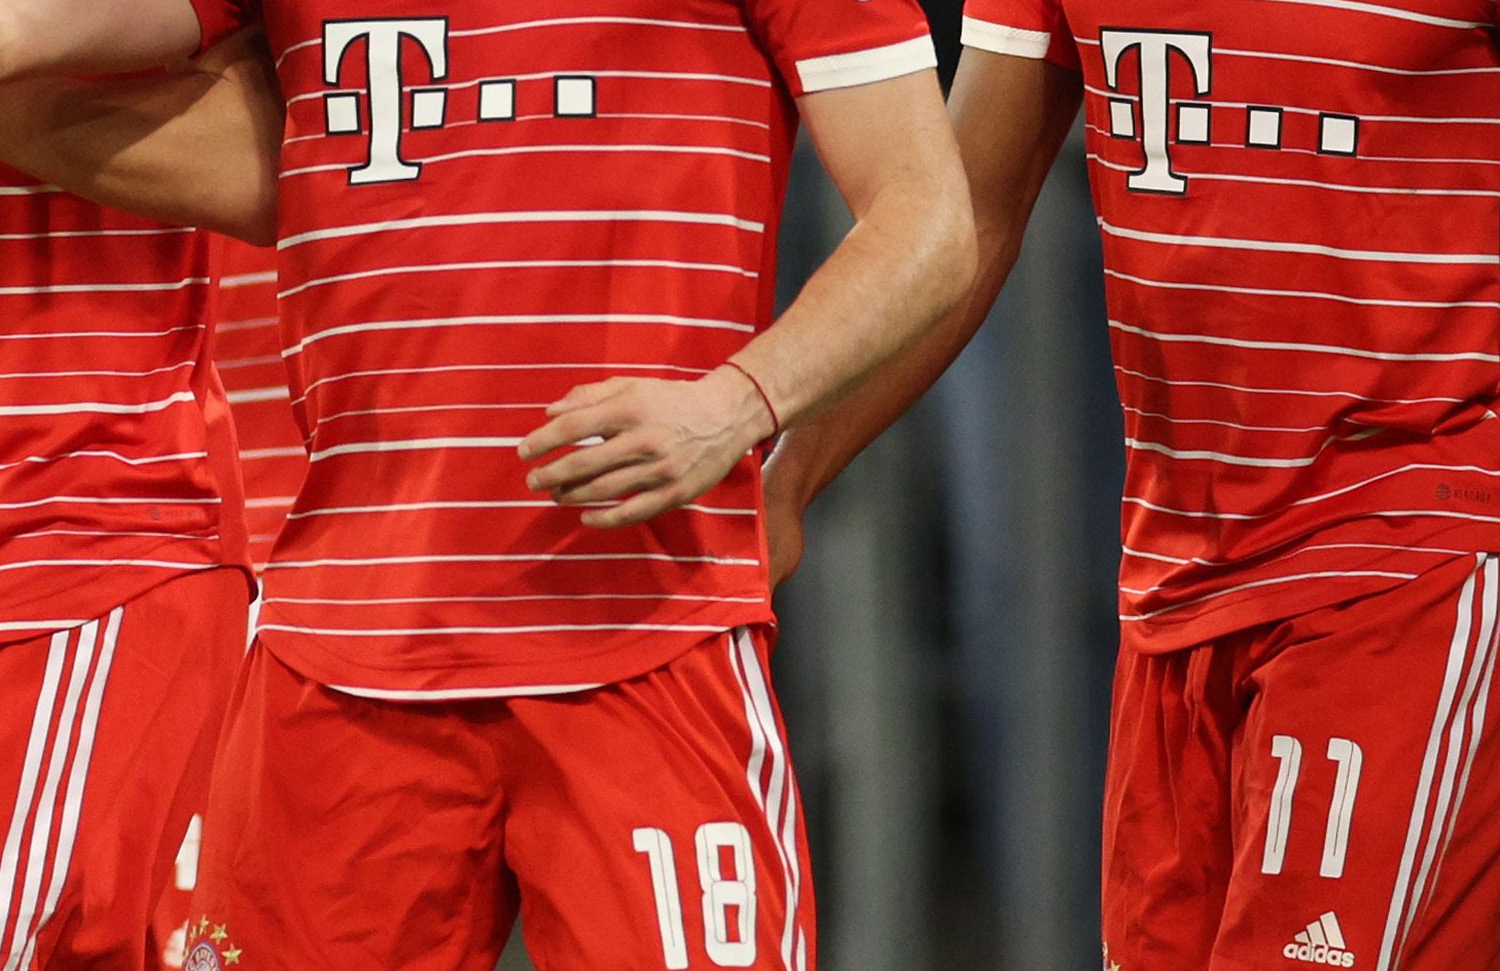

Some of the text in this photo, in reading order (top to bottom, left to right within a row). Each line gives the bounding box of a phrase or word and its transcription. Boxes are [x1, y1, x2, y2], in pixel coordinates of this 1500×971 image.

[1261, 734, 1363, 879] 11
[632, 821, 757, 970] 18
[1283, 943, 1356, 968] adidas
